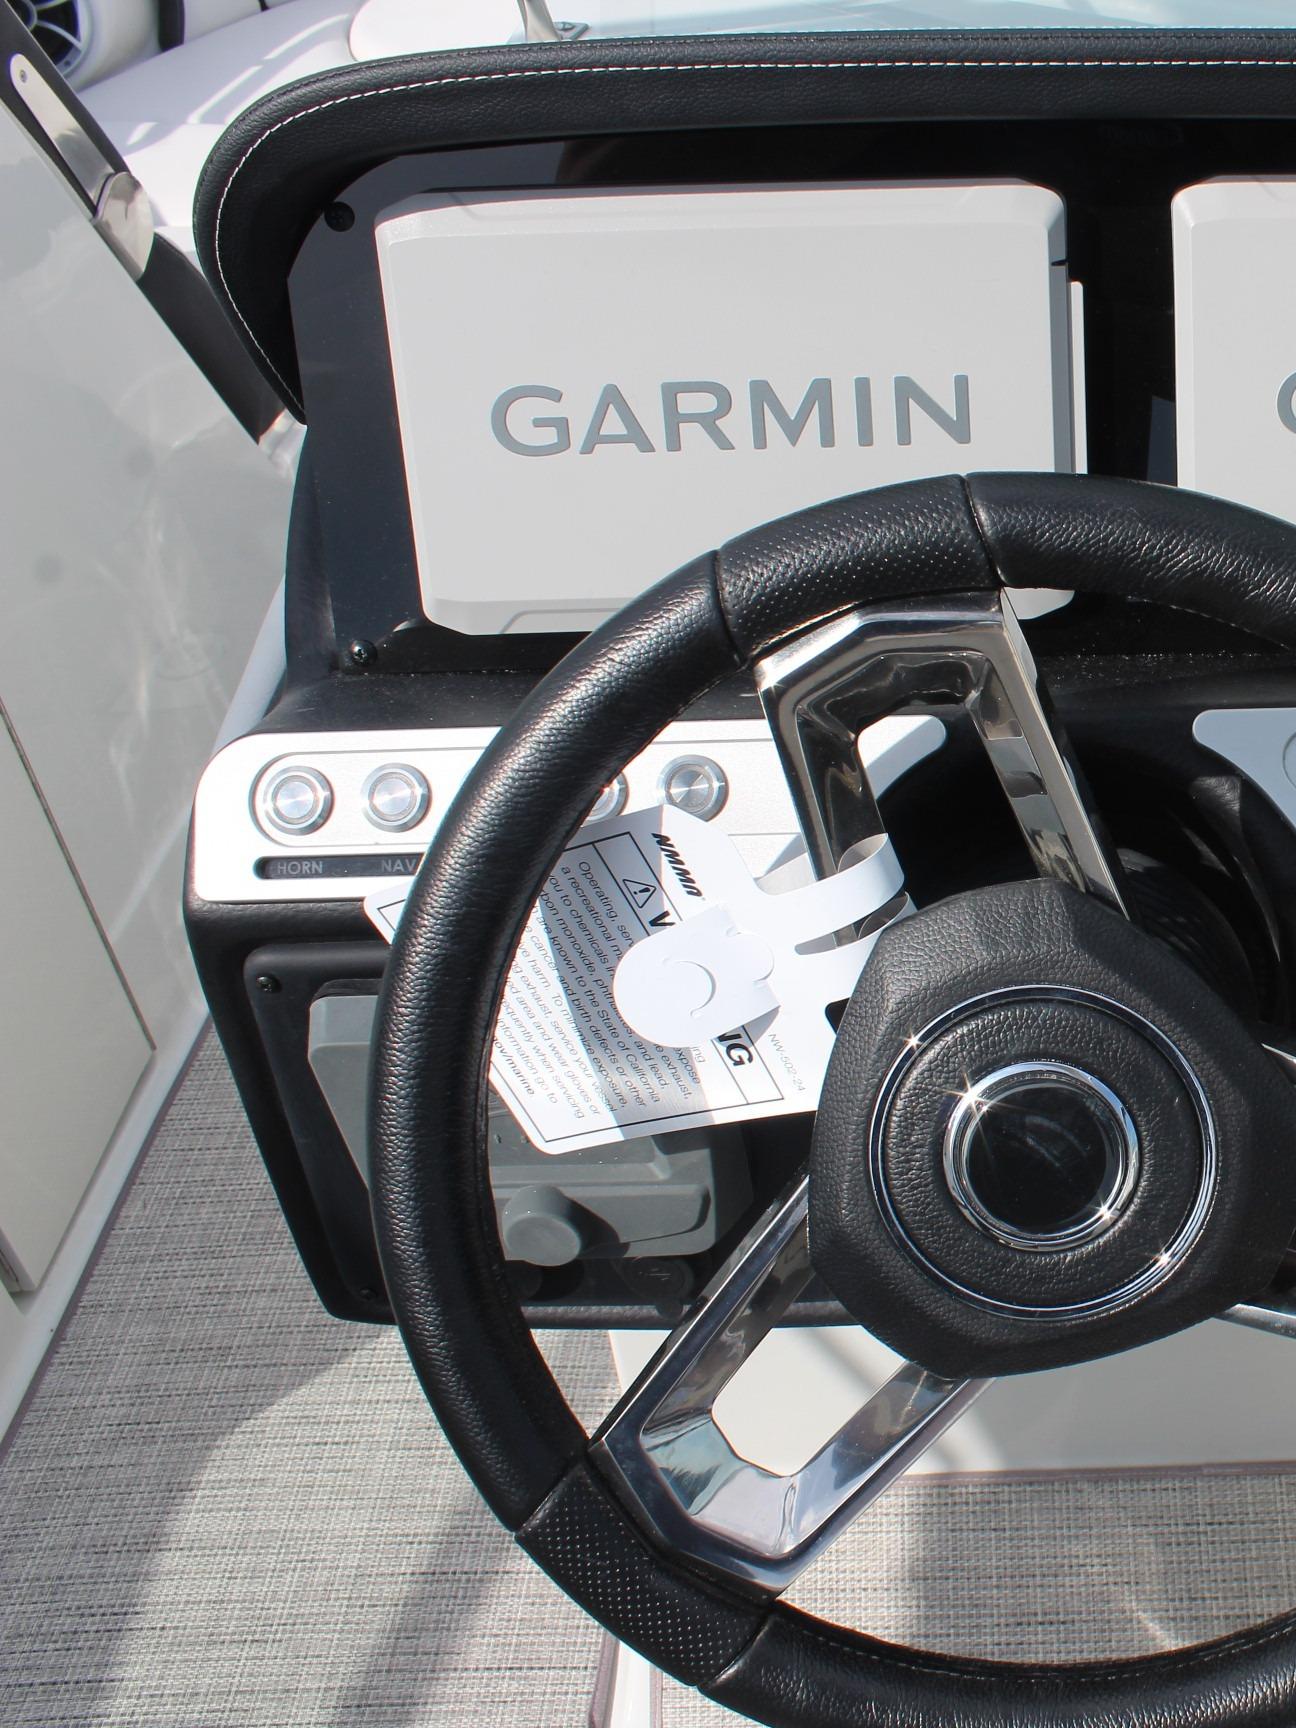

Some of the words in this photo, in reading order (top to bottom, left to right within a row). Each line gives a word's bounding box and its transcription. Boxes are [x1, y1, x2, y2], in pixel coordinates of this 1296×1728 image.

[491, 375, 971, 457] GARMIN
[276, 860, 323, 874] HORN
[566, 877, 616, 941] recreational
[576, 863, 621, 919] Operating,
[519, 975, 553, 1016] exhaust,
[549, 1020, 578, 1054] service
[573, 1059, 593, 1078] your
[591, 1081, 618, 1111] vessel
[527, 960, 552, 988] harm.
[550, 995, 565, 1004] To
[560, 1009, 596, 1053] minimize
[590, 1057, 629, 1105] exposure,
[529, 935, 560, 971] cancer
[556, 975, 576, 995] and
[571, 998, 593, 1021] birth
[588, 1025, 620, 1062] defects
[614, 1067, 628, 1078] or
[623, 1080, 648, 1107] other
[536, 916, 553, 933] are
[549, 936, 579, 971] known
[574, 976, 588, 986] to
[583, 990, 601, 1006] the
[596, 1010, 621, 1037] State
[615, 1040, 631, 1051] of
[624, 1054, 662, 1101] California
[554, 918, 599, 974] monoxide,
[632, 1040, 654, 1060] and
[647, 1064, 670, 1087] lead,
[559, 896, 573, 905] to
[568, 909, 610, 963] chemicals
[658, 1056, 694, 1096] exhaust,
[515, 997, 537, 1018] area
[532, 1021, 552, 1040] and
[548, 1044, 568, 1066] wear
[563, 1071, 592, 1102] gloves
[587, 1105, 600, 1114] or
[531, 1046, 556, 1072] when
[550, 1075, 586, 1117] servicing
[534, 1078, 549, 1090] go
[546, 1093, 559, 1102] to
